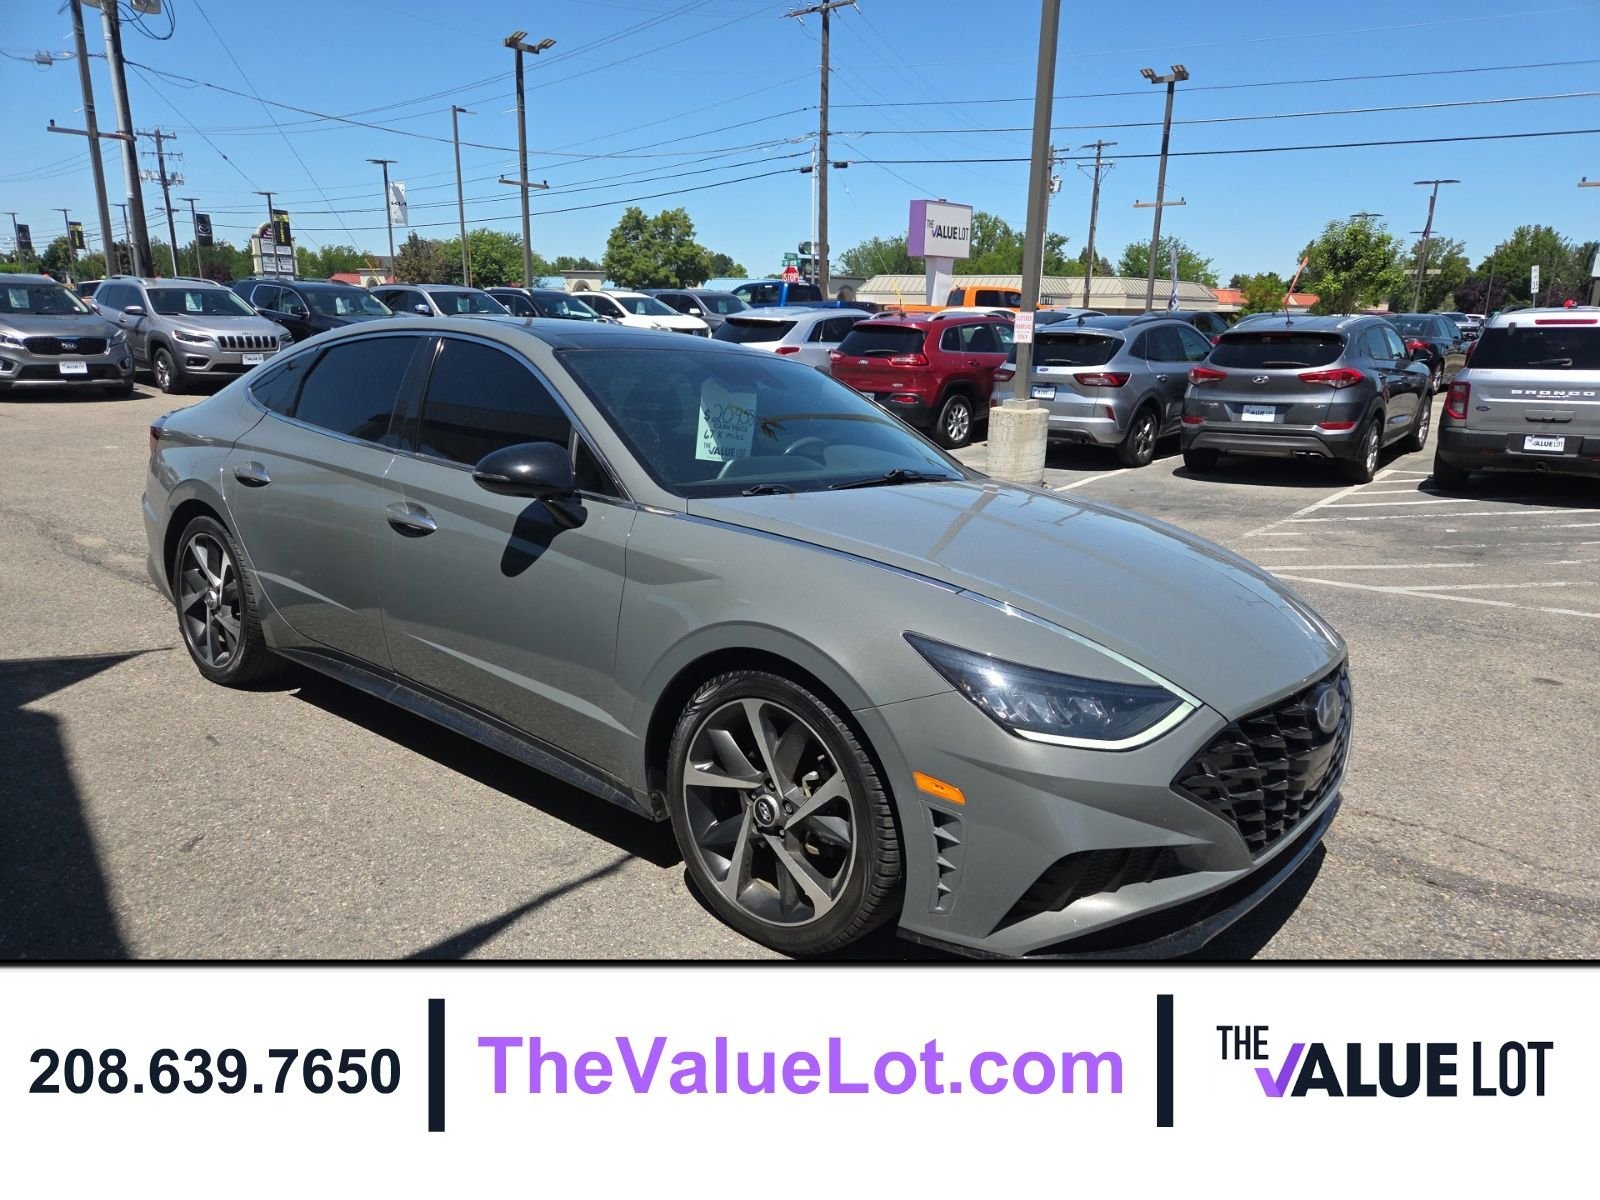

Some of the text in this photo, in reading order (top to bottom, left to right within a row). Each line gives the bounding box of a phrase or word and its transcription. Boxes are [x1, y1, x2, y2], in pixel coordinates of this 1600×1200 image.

[931, 225, 957, 239] VALUE
[958, 227, 969, 240] LOT
[783, 272, 799, 282] STOP
[709, 447, 735, 457] VALUE
